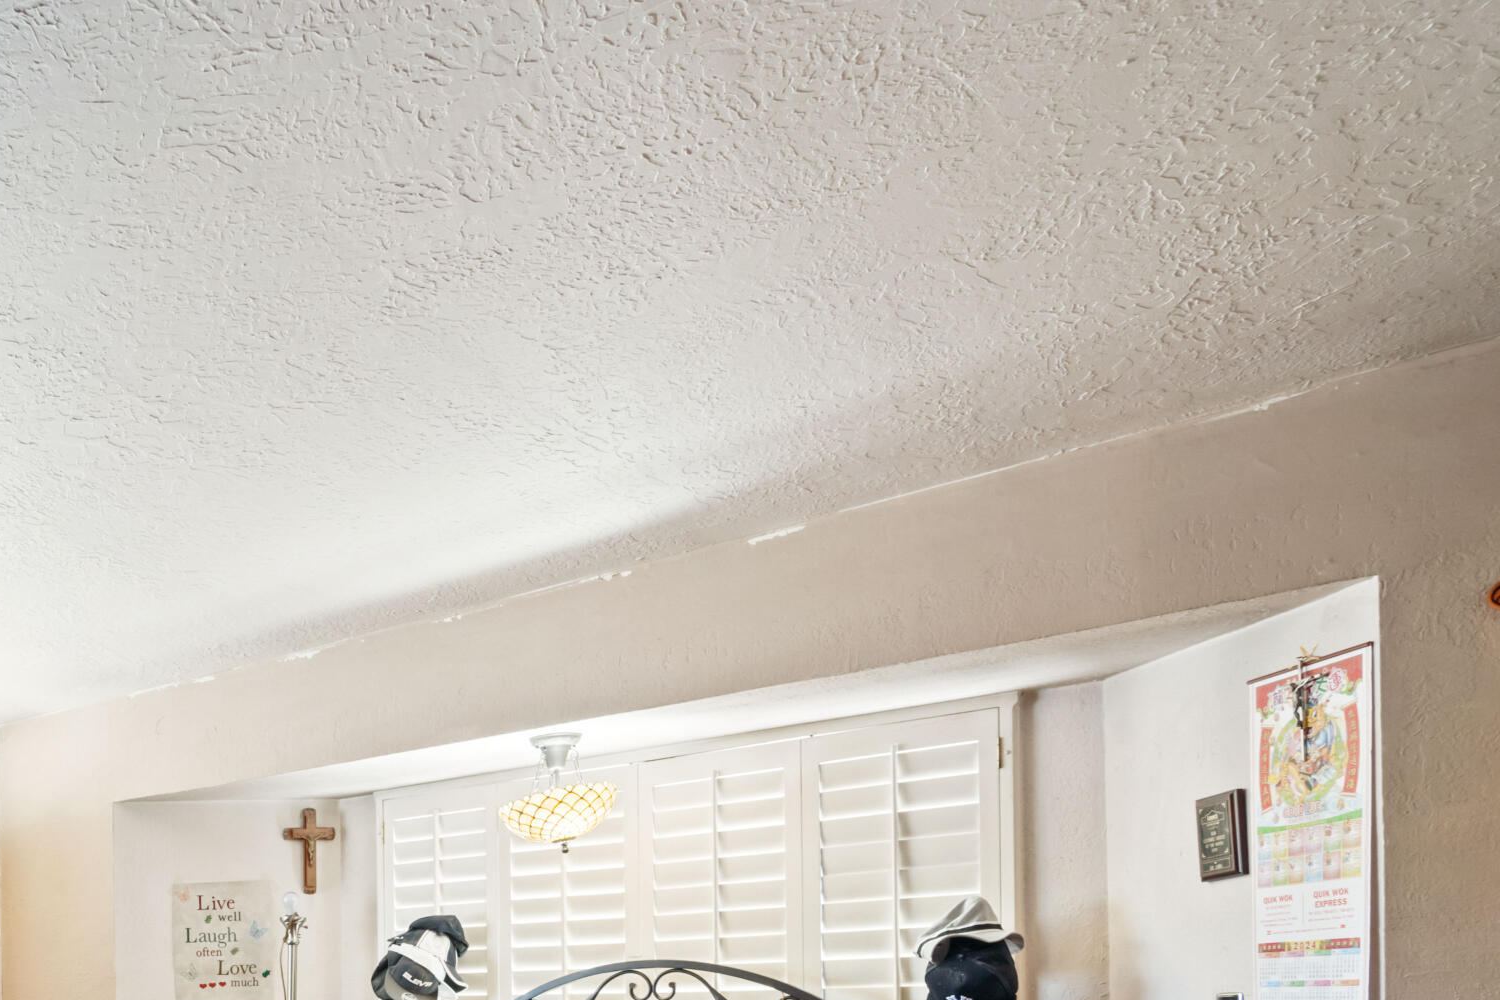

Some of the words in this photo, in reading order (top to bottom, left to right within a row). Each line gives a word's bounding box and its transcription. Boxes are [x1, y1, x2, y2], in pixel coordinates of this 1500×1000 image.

[1313, 890, 1330, 899] QUIK
[1332, 888, 1349, 896] WOK
[196, 894, 235, 911] Live
[1263, 896, 1277, 905] QUIK
[1278, 894, 1293, 902] WOK
[1314, 898, 1347, 908] EXPRESS
[218, 911, 242, 922] well
[185, 926, 238, 948] Laugh
[195, 947, 223, 957] often
[217, 960, 257, 976] Love
[230, 977, 260, 987] much
